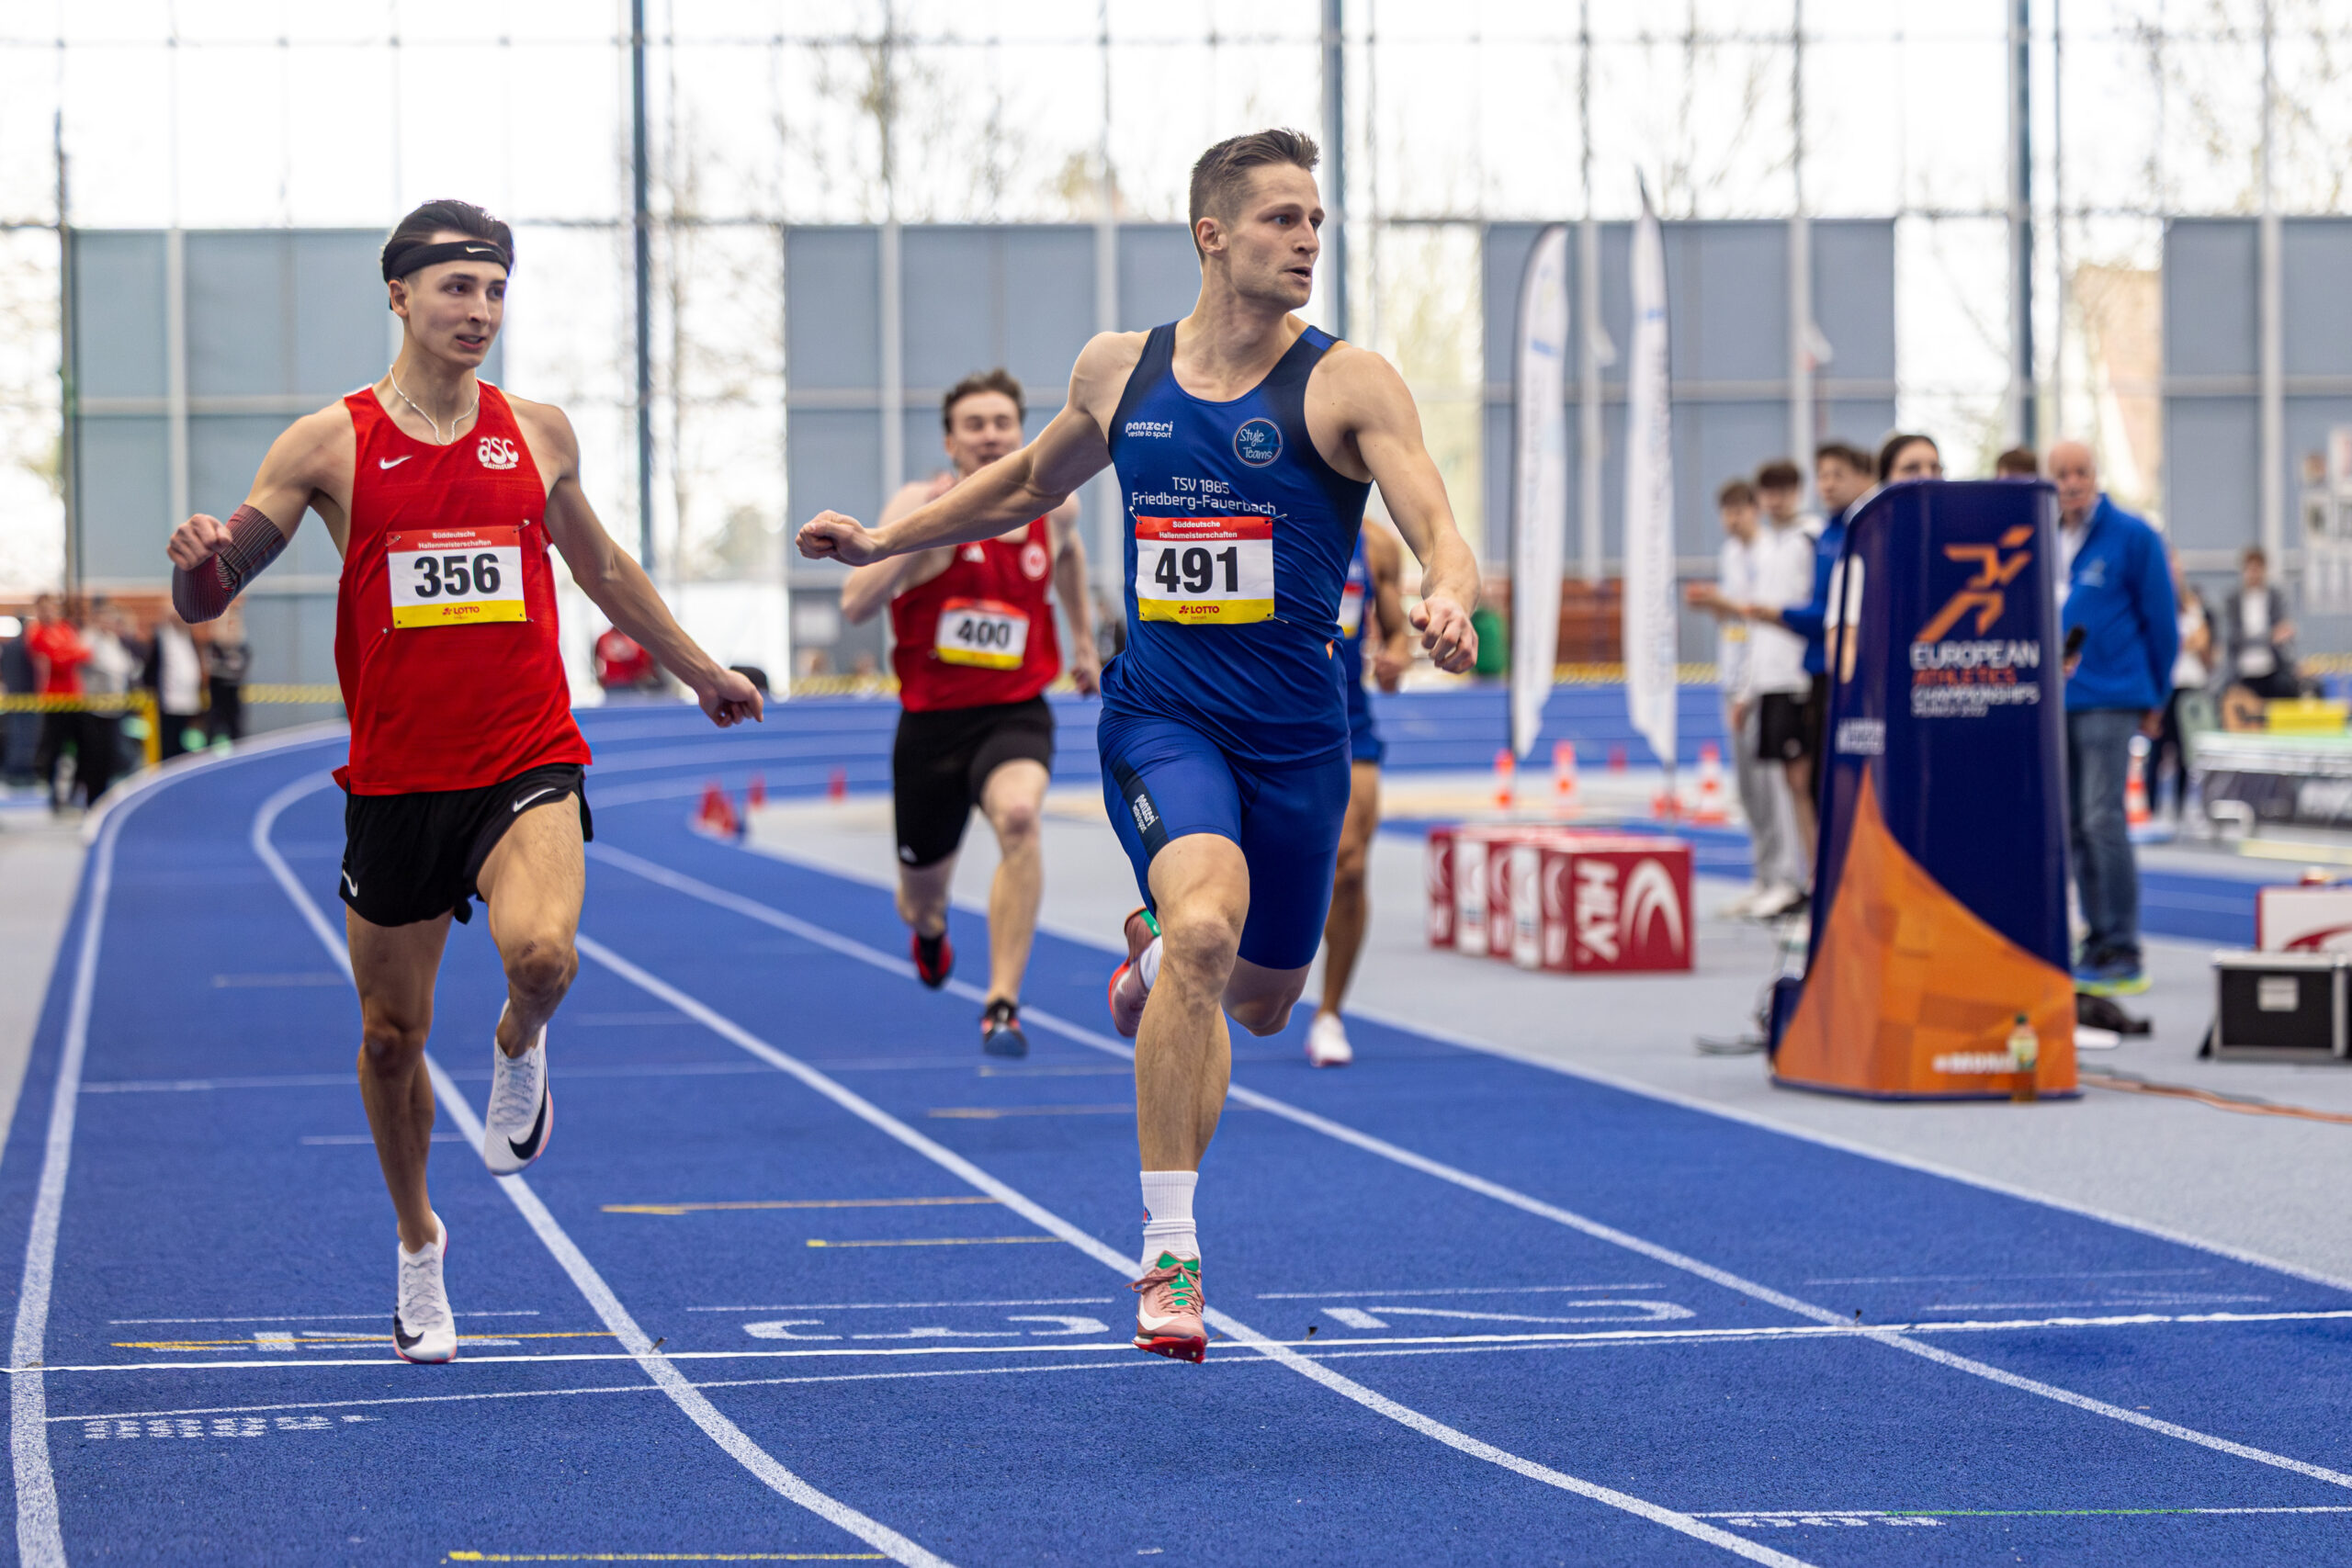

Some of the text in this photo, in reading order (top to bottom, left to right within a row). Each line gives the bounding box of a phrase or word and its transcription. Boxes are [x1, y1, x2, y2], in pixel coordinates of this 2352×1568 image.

[1125, 421, 1173, 434] panzeri
[1152, 431, 1172, 439] sport
[1239, 428, 1265, 447] Style
[478, 437, 519, 464] asc
[1243, 446, 1272, 459] Teams
[1172, 477, 1230, 495] TSV 1885
[1132, 491, 1277, 515] Friedberg-Fauerbach
[1172, 520, 1221, 528] Süddeutsche
[432, 531, 476, 539] Süddeutsche
[1159, 531, 1238, 539] Hallenmeisterschaften
[418, 539, 492, 549] Hallenmeisterschaften
[413, 553, 502, 598] 356
[1155, 547, 1238, 593] 491
[453, 606, 480, 615] LOTTO
[1191, 605, 1219, 615] LOTTO
[957, 617, 1012, 649] 400
[1909, 640, 2041, 670] EUROPEAN
[1911, 666, 2018, 686] ATHLETICS
